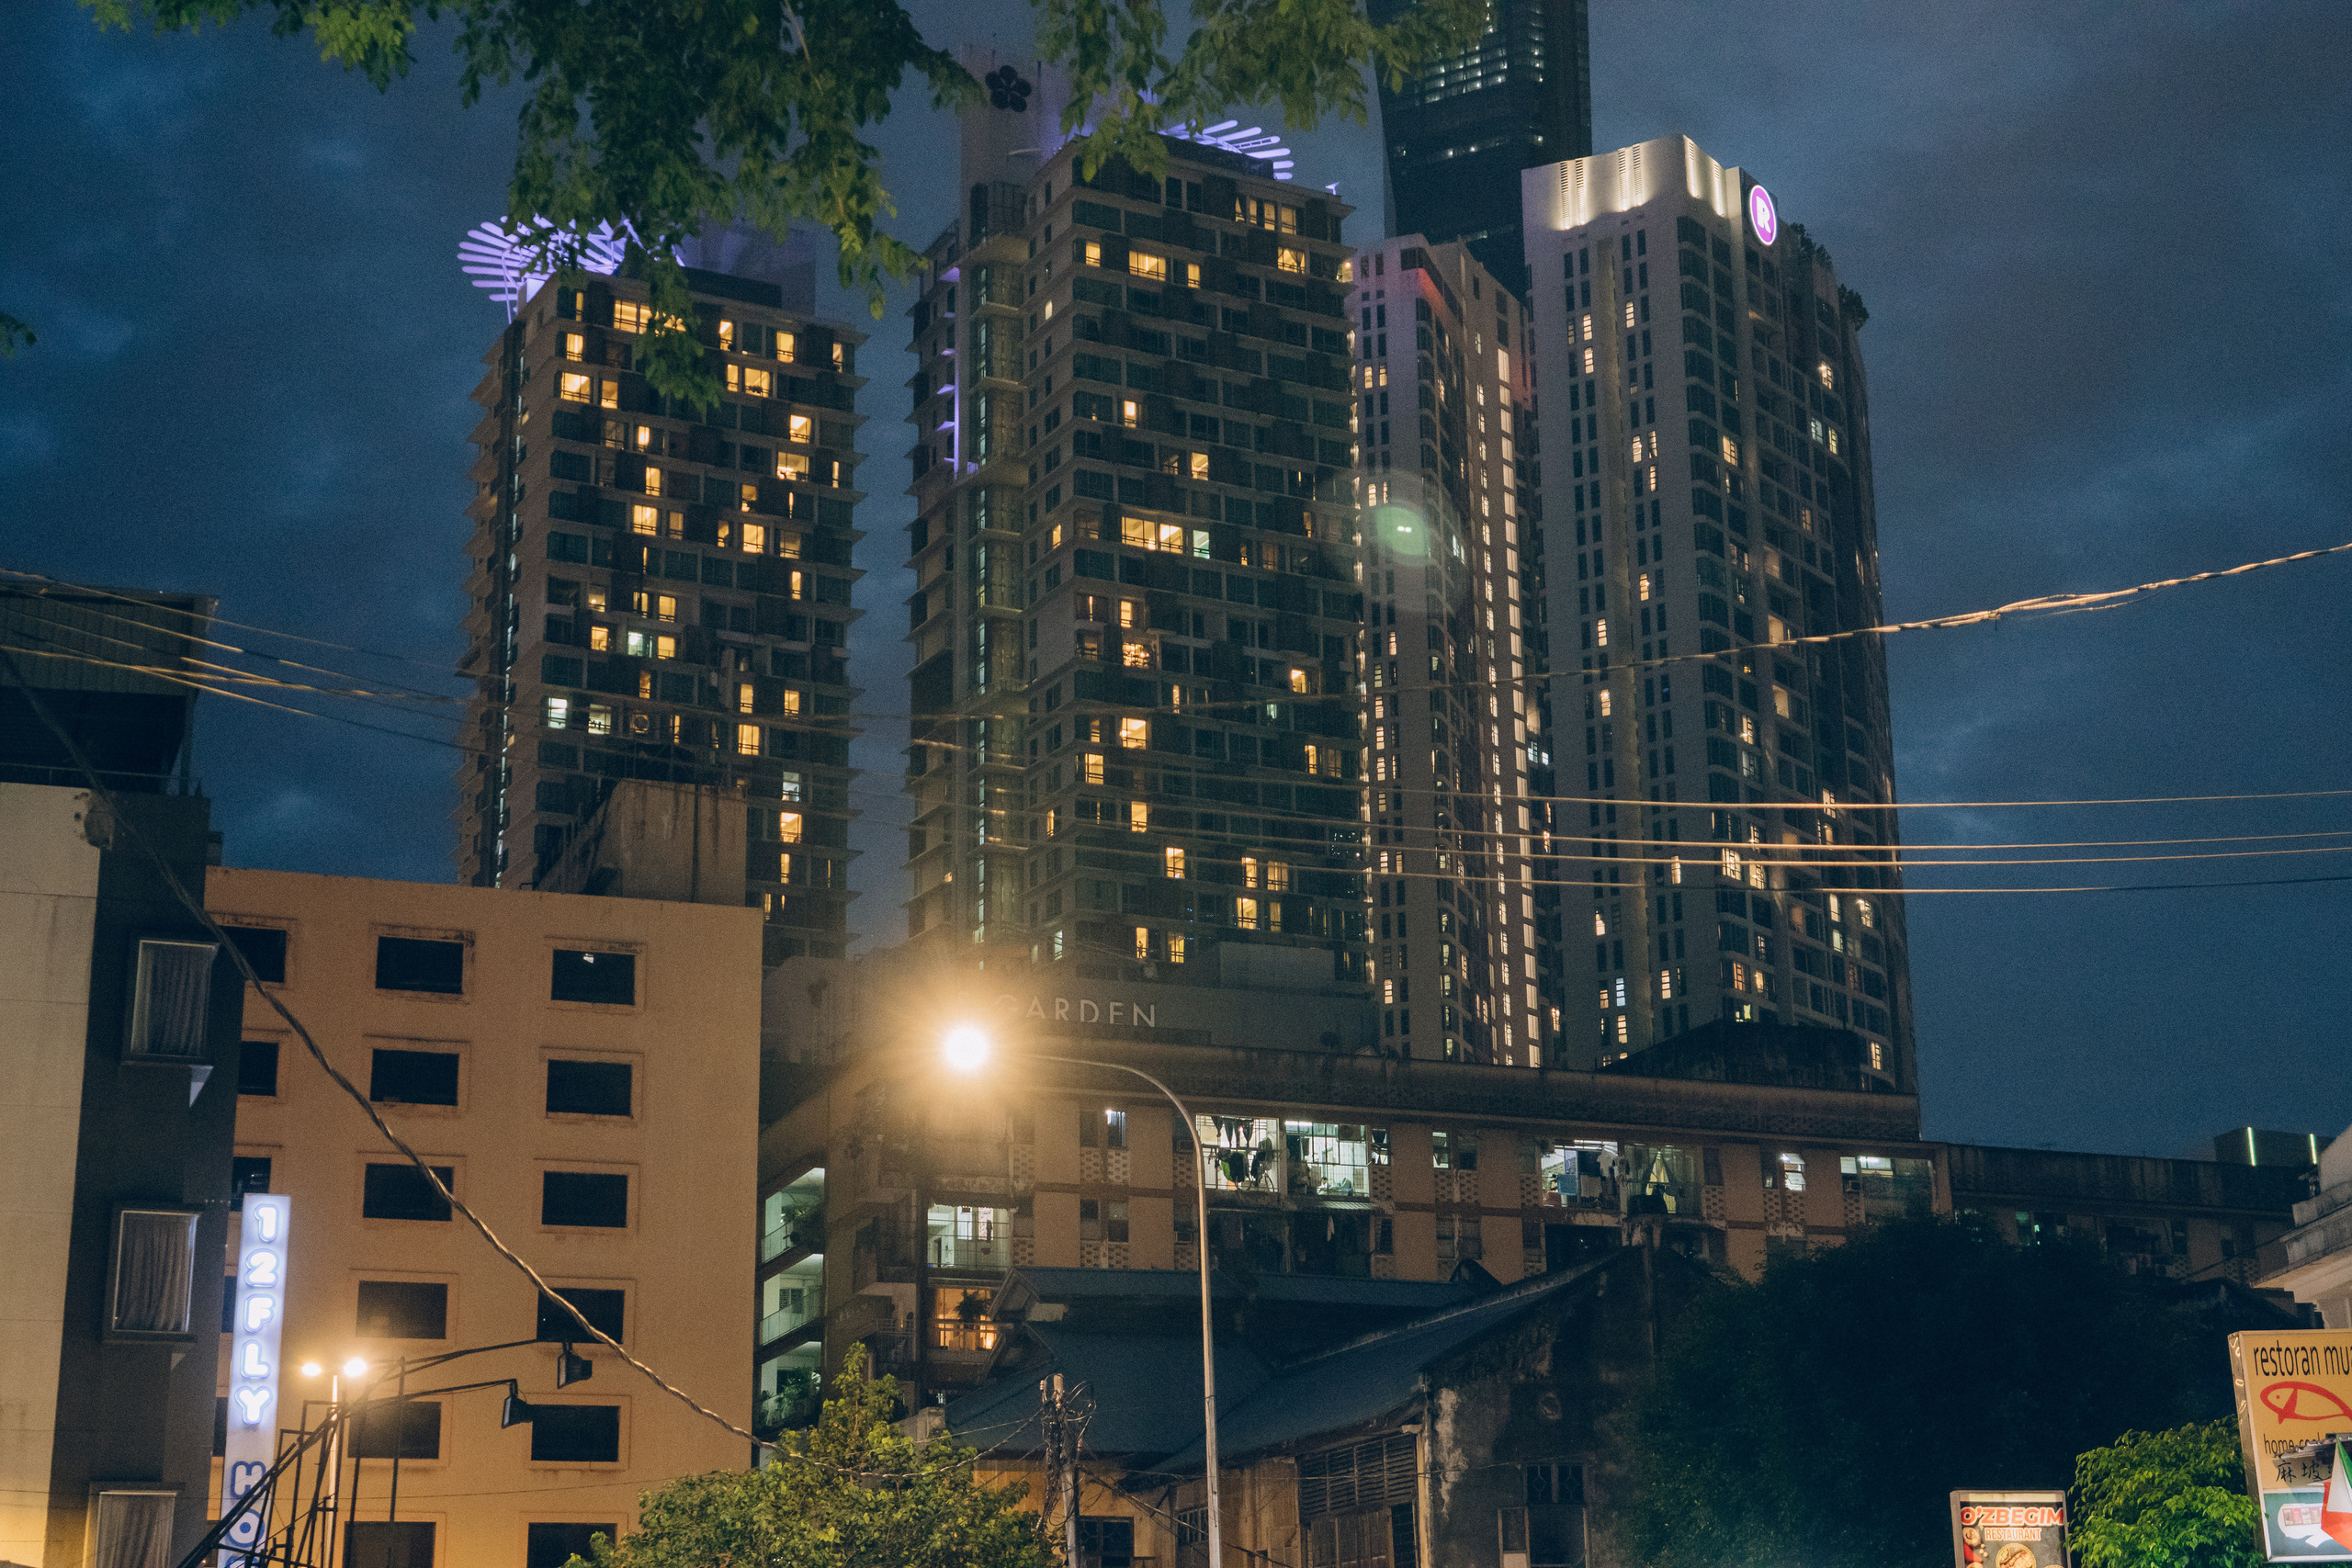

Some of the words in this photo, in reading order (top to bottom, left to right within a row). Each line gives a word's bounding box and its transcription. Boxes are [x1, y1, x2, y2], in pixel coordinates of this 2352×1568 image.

[234, 1203, 279, 1426] 12FLY
[2253, 1339, 2321, 1376] restoran
[2324, 1346, 2352, 1376] mu
[2276, 1459, 2333, 1483] 麻坡
[224, 1461, 266, 1568] HO
[1961, 1506, 2064, 1526] O'ZBEGIM
[1984, 1528, 2041, 1541] RESTAURANT
